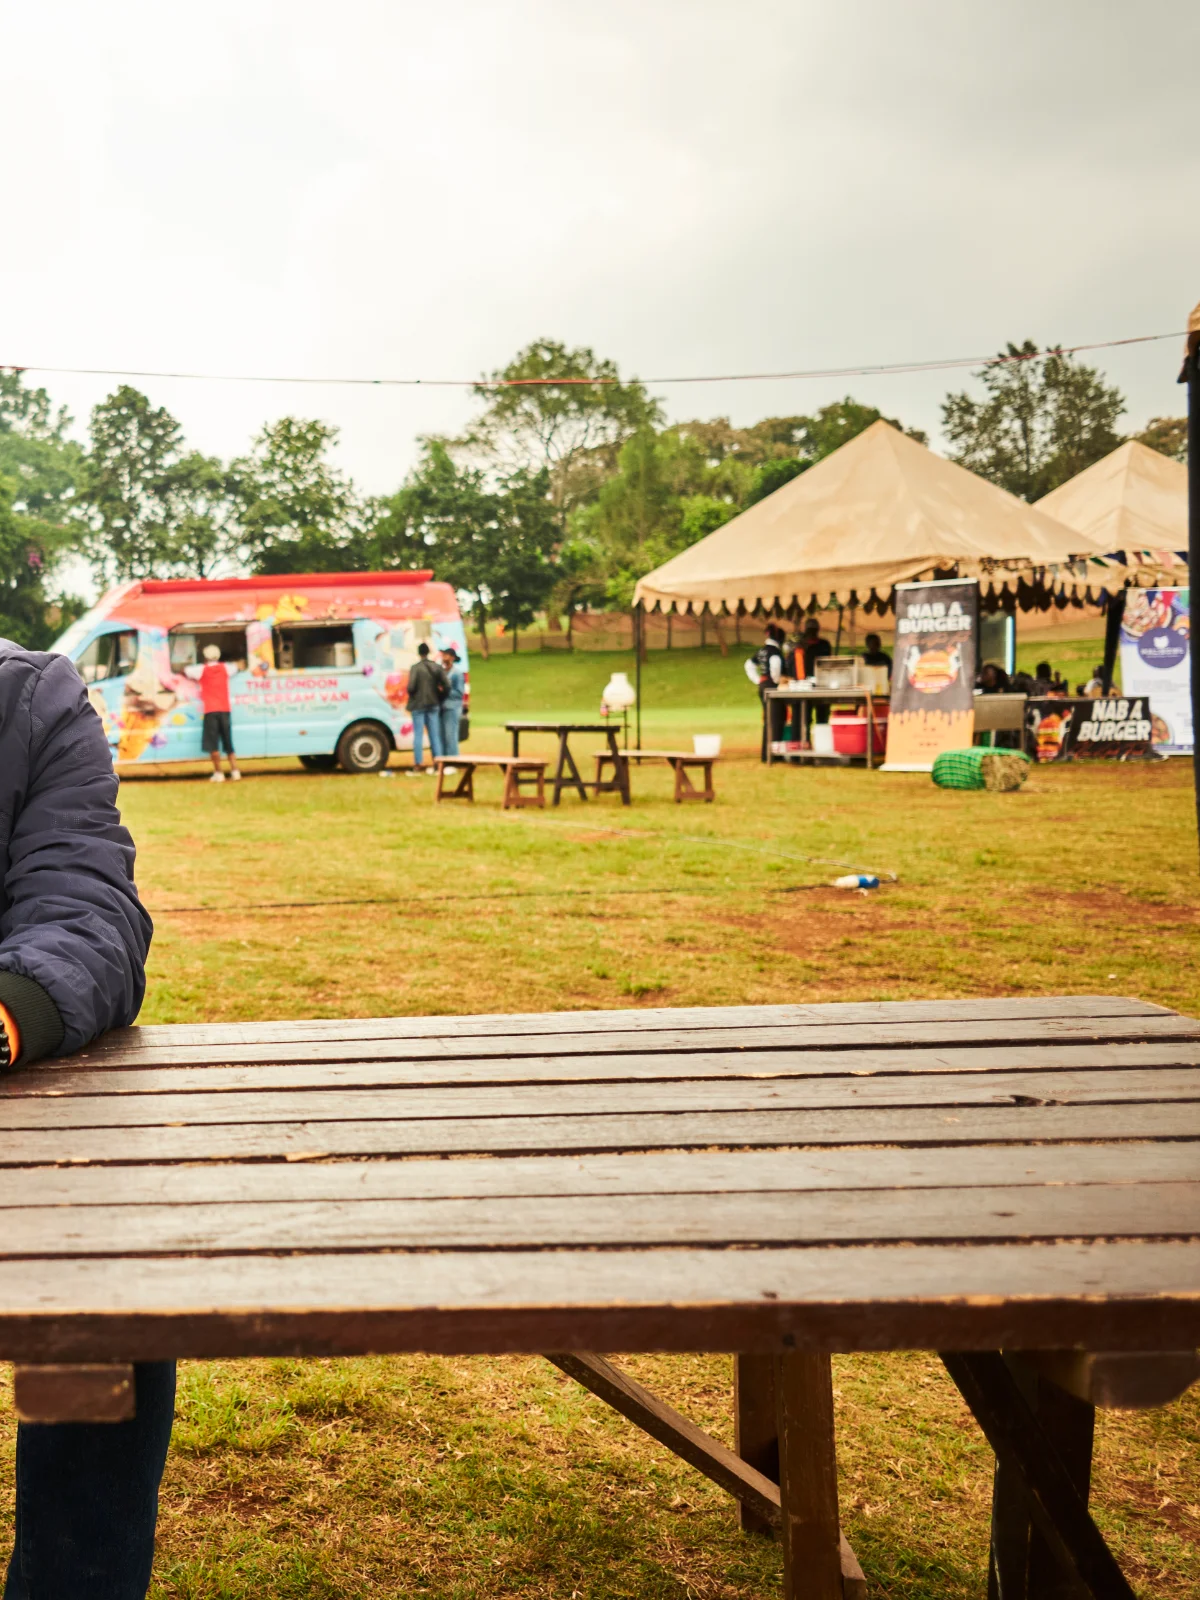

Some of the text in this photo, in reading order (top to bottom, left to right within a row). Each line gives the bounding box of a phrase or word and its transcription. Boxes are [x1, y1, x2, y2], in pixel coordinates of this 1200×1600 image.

[907, 601, 963, 619] NAB A
[898, 615, 971, 633] BURGER
[246, 677, 338, 691] THE LONDON
[264, 692, 315, 704] CREAM
[320, 690, 349, 702] VAN
[1091, 699, 1143, 721] NAB A
[1077, 719, 1151, 742] BURGER
